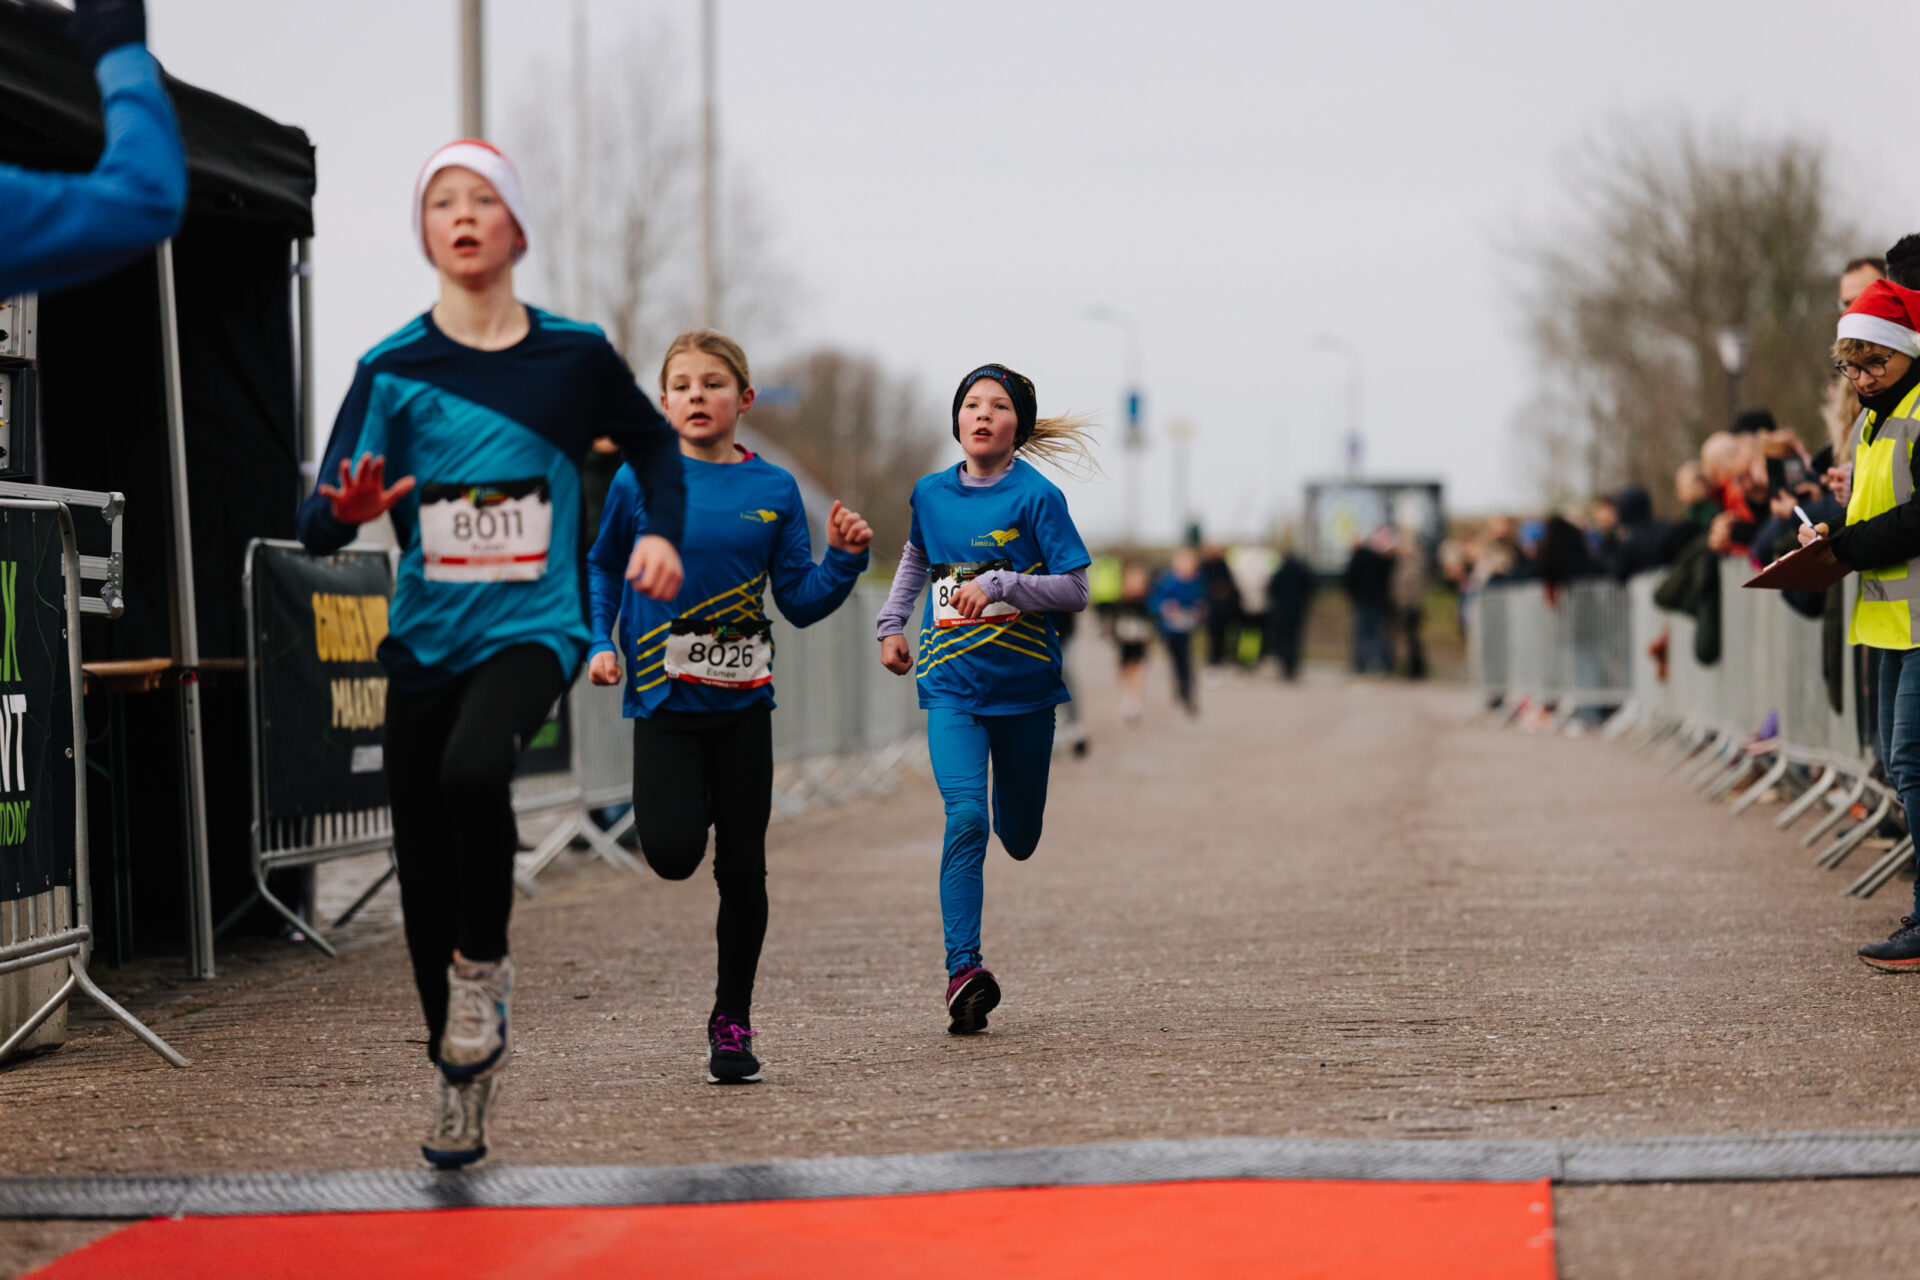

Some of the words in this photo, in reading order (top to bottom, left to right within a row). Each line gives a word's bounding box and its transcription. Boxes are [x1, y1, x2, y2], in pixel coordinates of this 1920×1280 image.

[453, 510, 524, 541] 8011
[688, 642, 754, 668] 8026
[706, 667, 737, 679] Esmee
